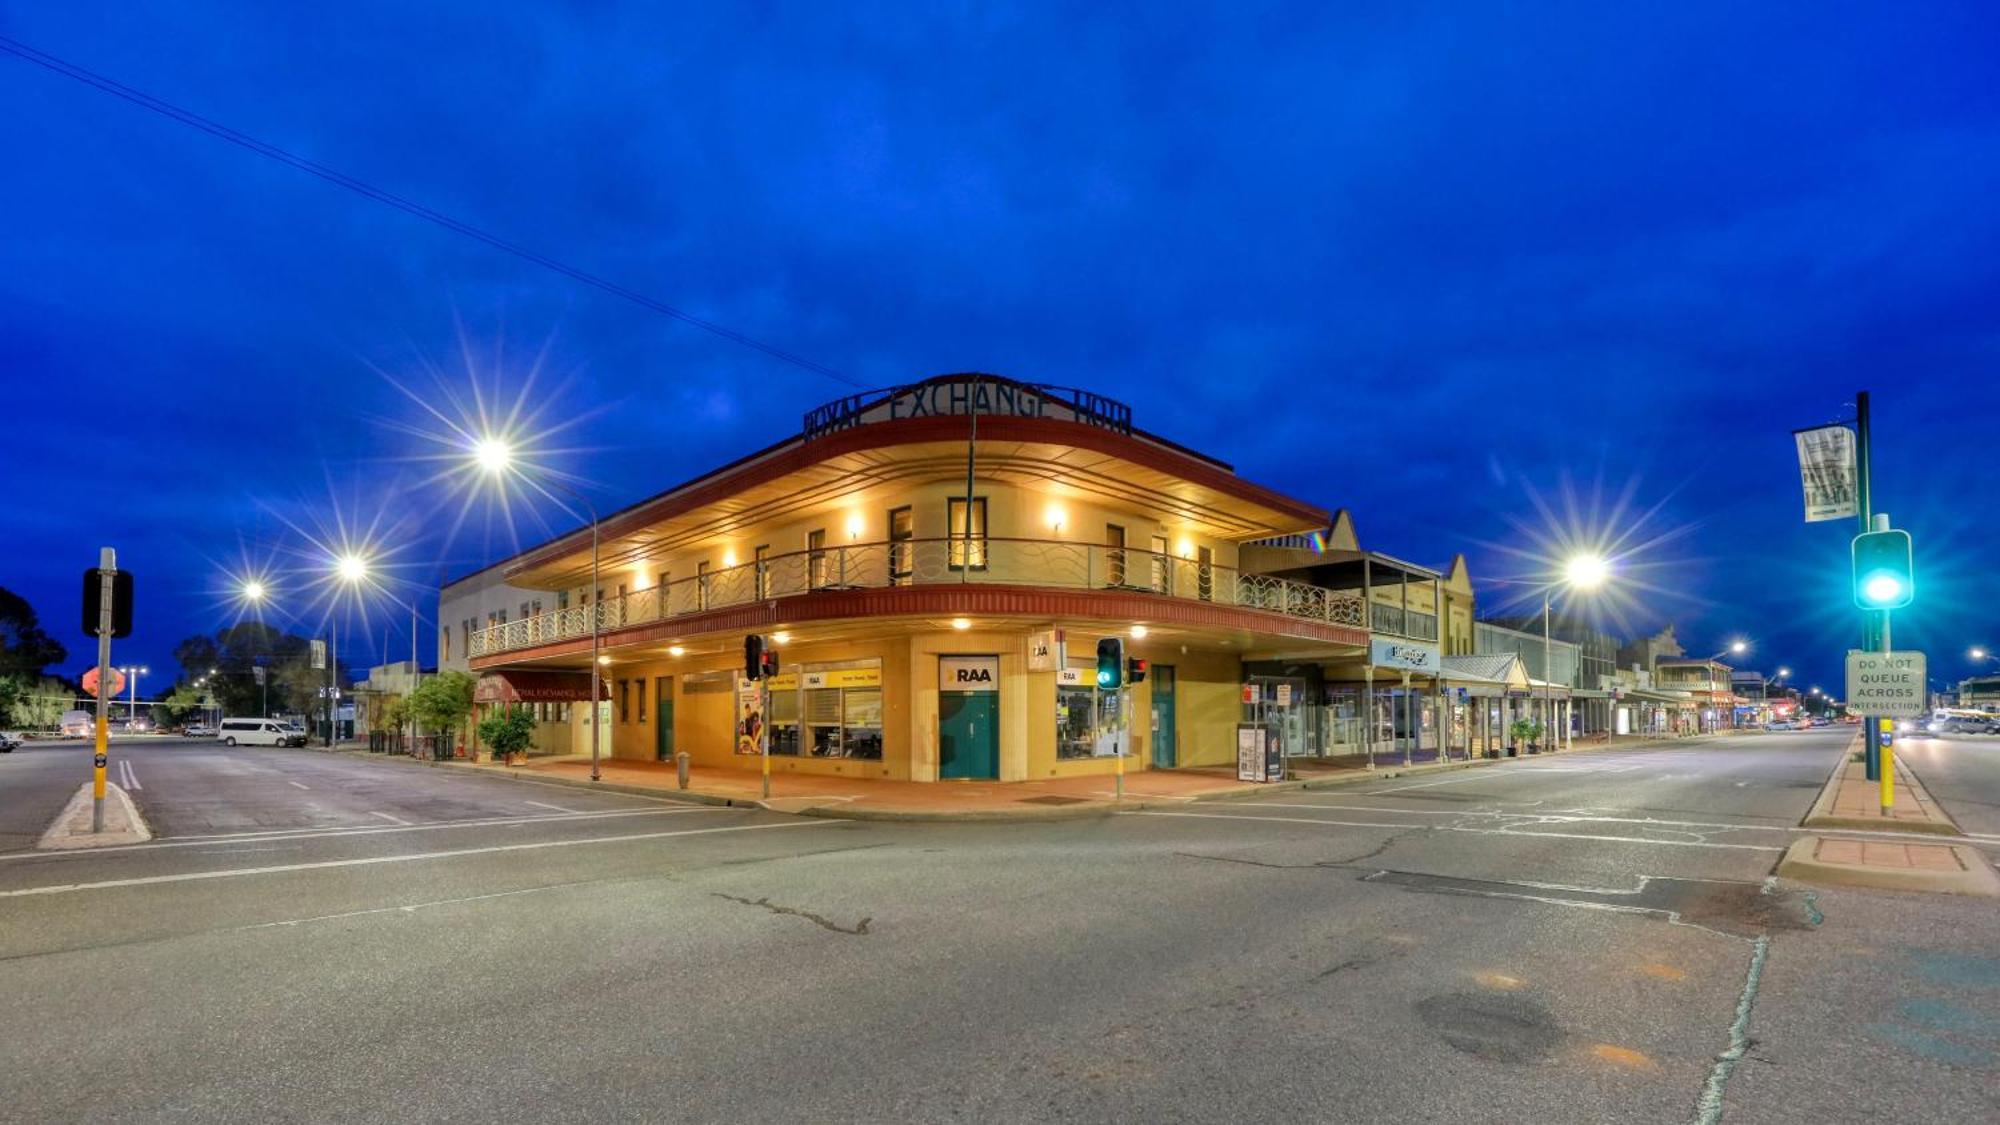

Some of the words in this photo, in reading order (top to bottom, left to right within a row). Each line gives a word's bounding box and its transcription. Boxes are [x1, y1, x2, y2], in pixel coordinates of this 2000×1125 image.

[803, 395, 867, 442] ROYAL
[891, 382, 1051, 420] EXCHANGE
[1074, 389, 1132, 436] HOTEL
[1859, 661, 1877, 669] DO
[1884, 660, 1912, 668] NOT
[957, 669, 991, 682] RAA
[1064, 672, 1076, 681] RAA
[1861, 674, 1910, 683] QUEUE
[1858, 688, 1913, 697] ACROSS
